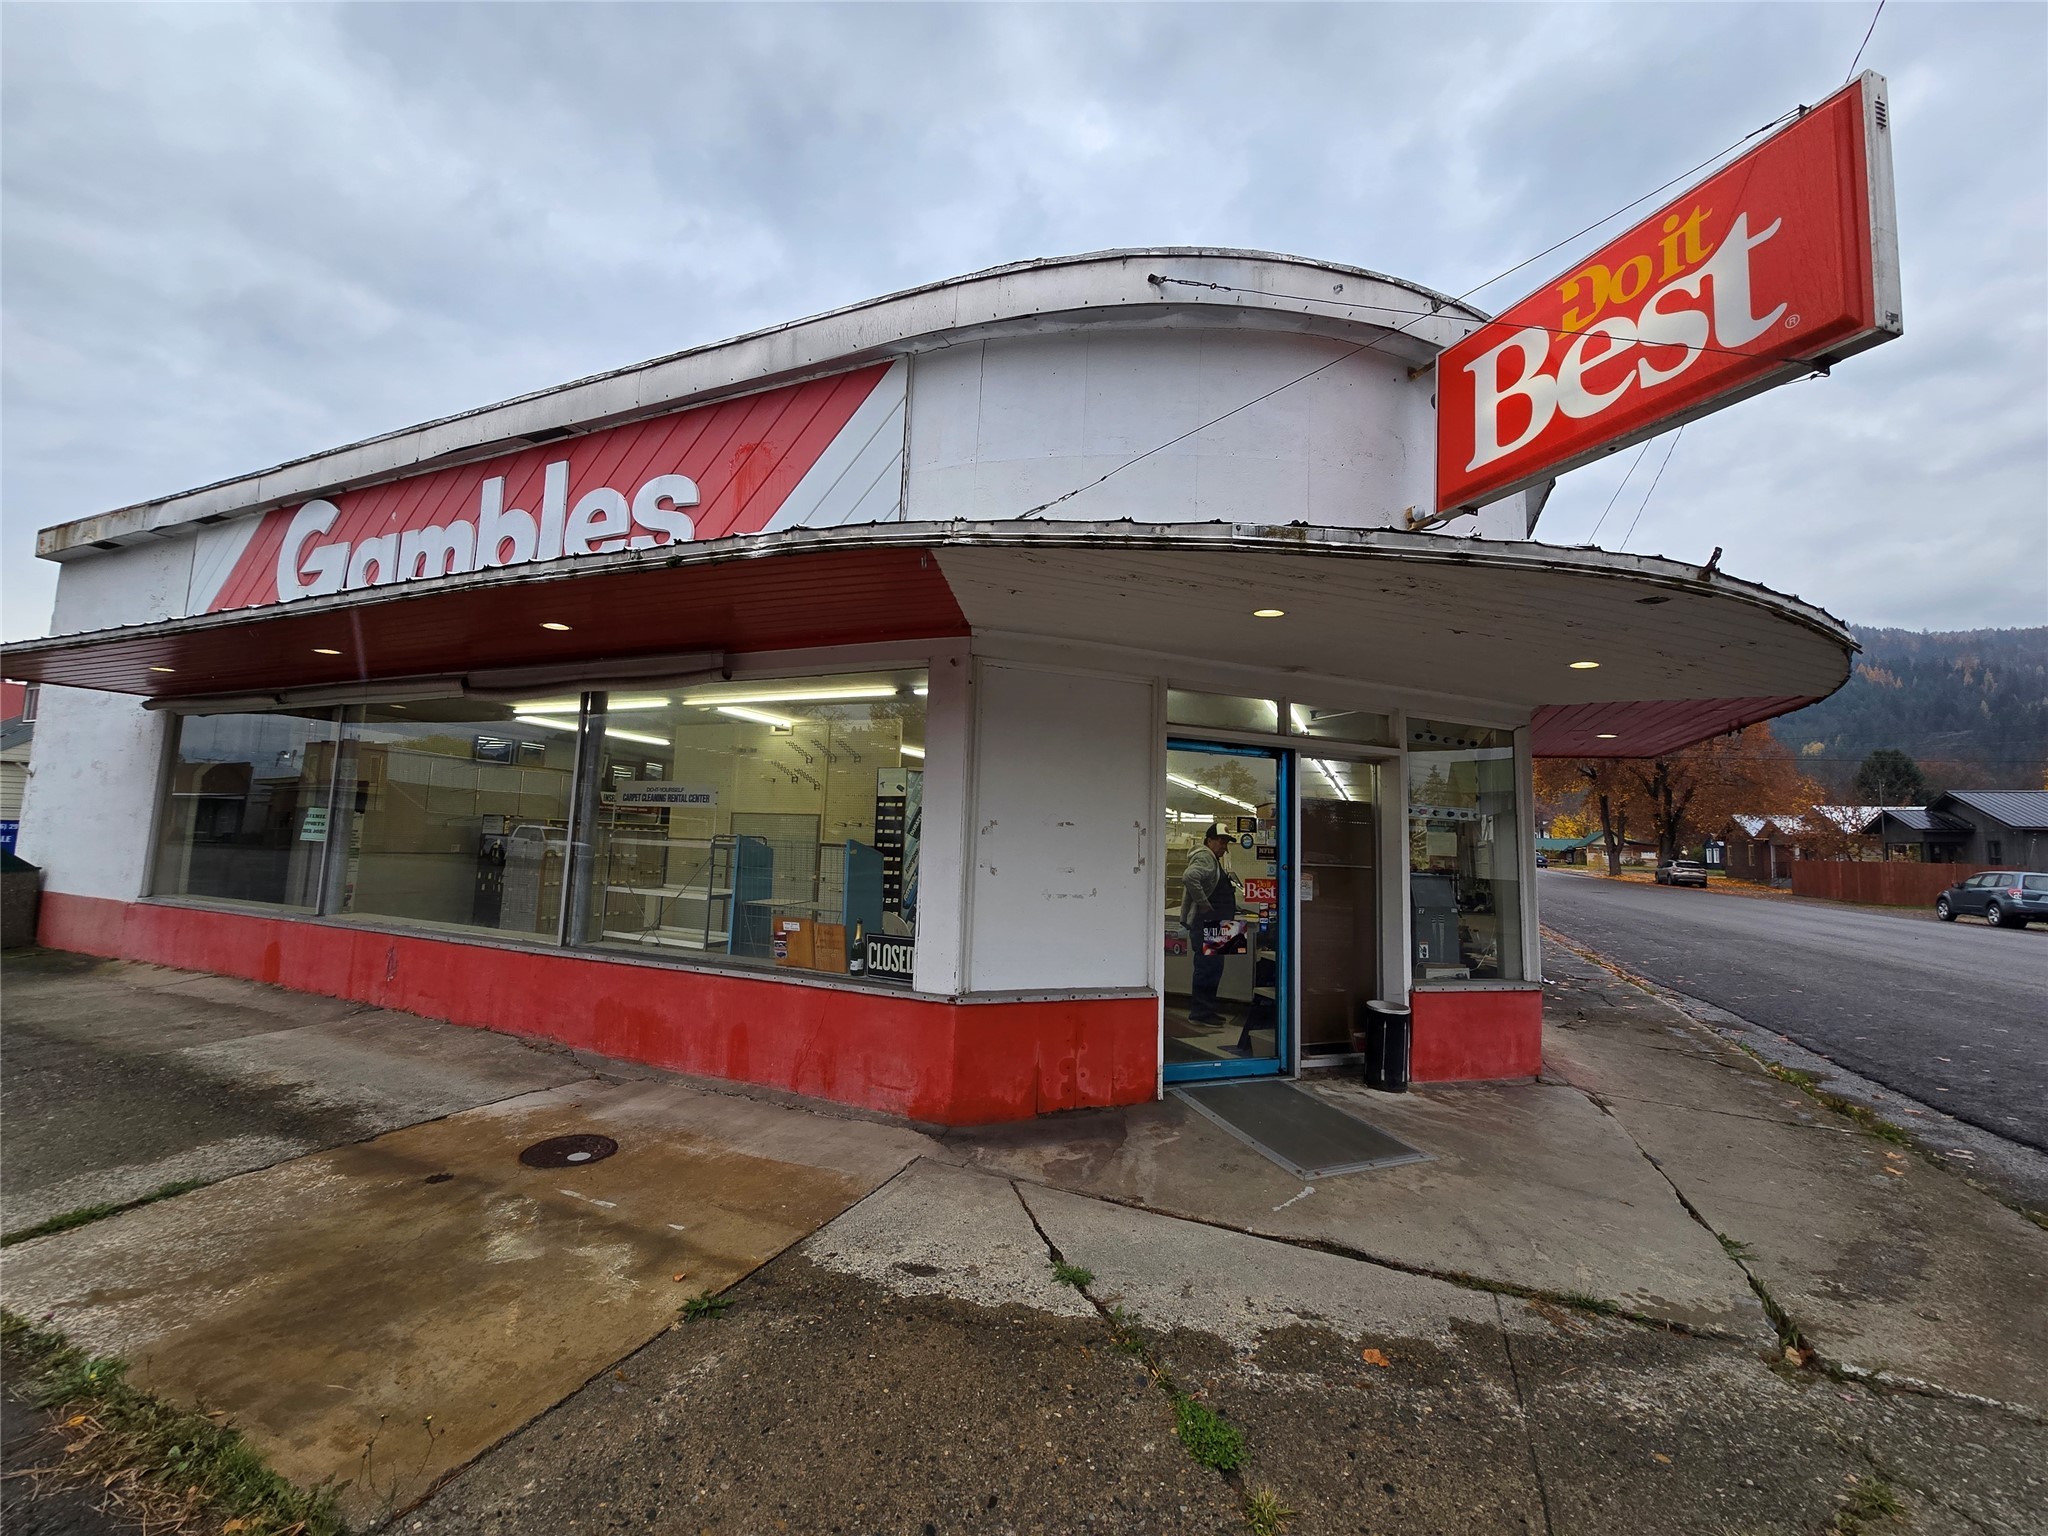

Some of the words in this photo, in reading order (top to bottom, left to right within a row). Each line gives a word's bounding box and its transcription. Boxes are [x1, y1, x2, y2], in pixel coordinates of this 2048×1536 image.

[1557, 253, 1653, 341] Do
[1657, 203, 1715, 285] it
[1462, 210, 1788, 473] Best
[276, 460, 700, 601] Gambles
[622, 793, 641, 802] CARPET
[641, 793, 666, 803] CLEANING
[667, 794, 688, 803] RENTAL
[688, 794, 710, 804] CENTER
[1246, 882, 1276, 899] Best
[1256, 880, 1267, 888] Do
[868, 941, 915, 974] CLOSED
